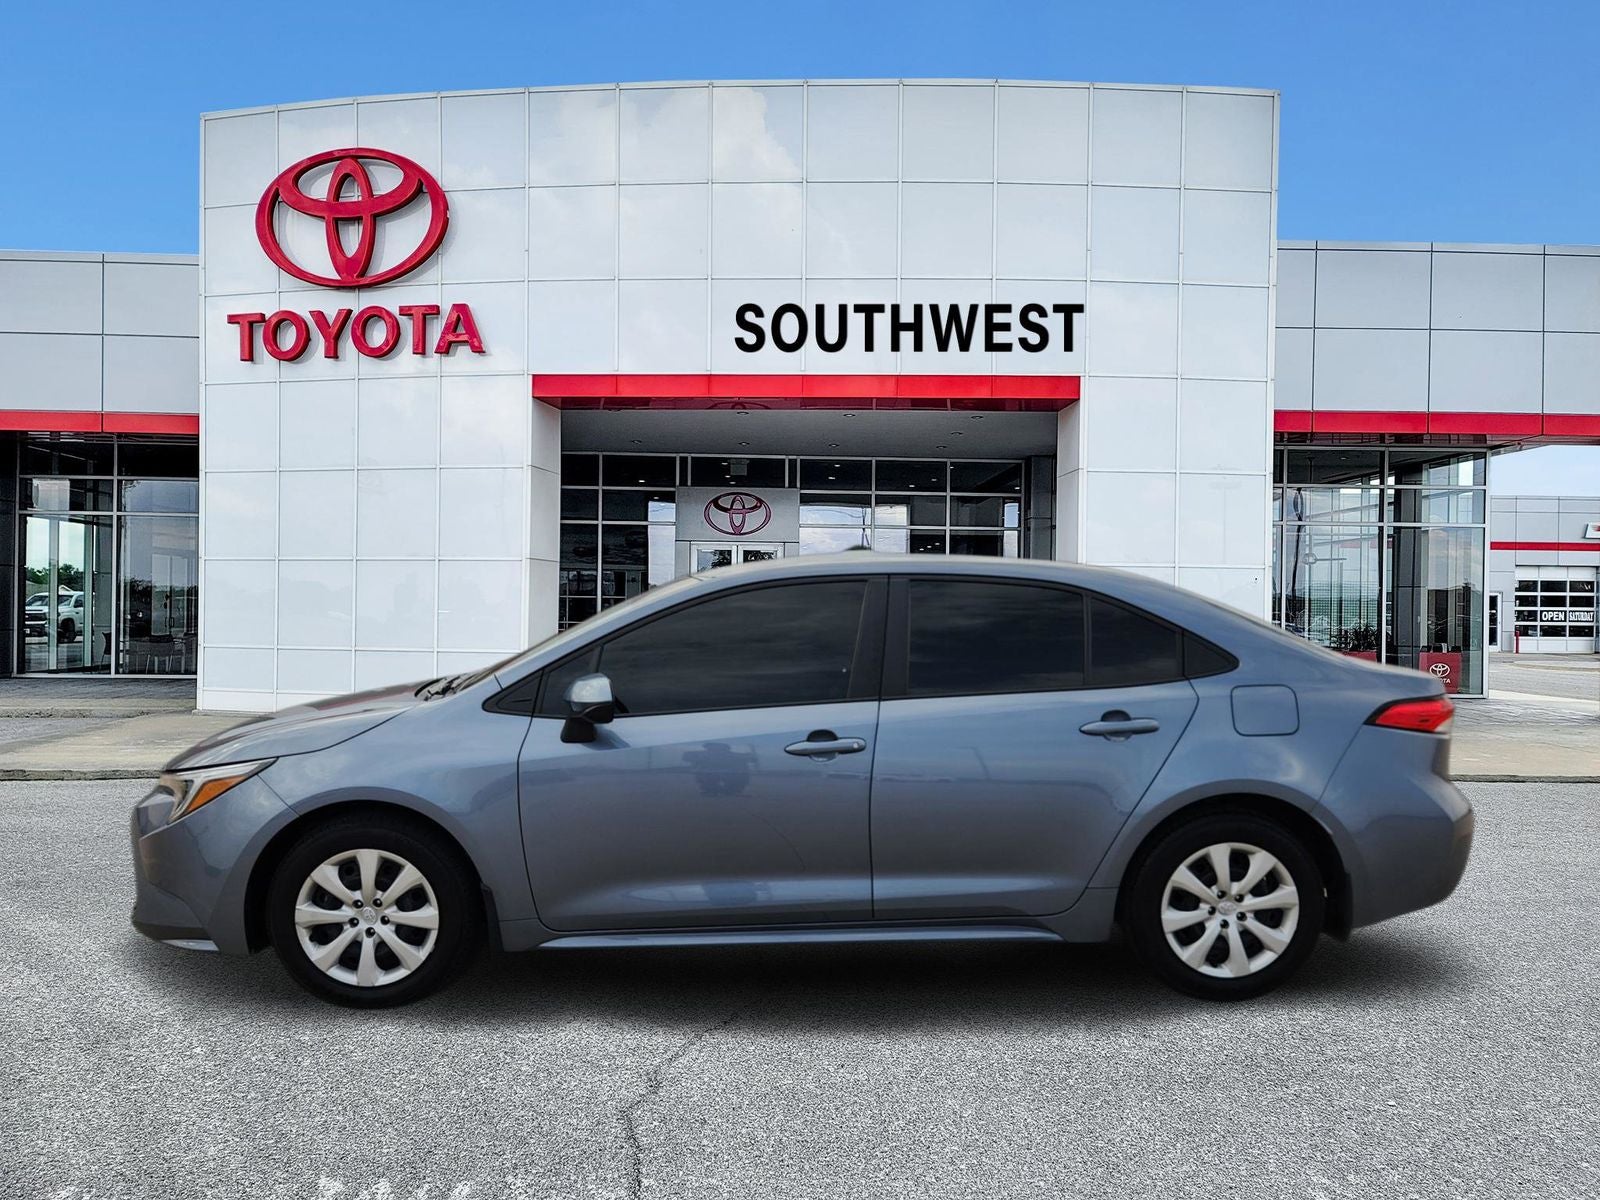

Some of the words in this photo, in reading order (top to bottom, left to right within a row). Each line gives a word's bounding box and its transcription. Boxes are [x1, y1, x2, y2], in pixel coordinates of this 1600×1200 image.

[227, 303, 485, 362] TOYOTA
[734, 303, 1085, 353] SOUTHWEST
[1542, 611, 1565, 621] OPEN
